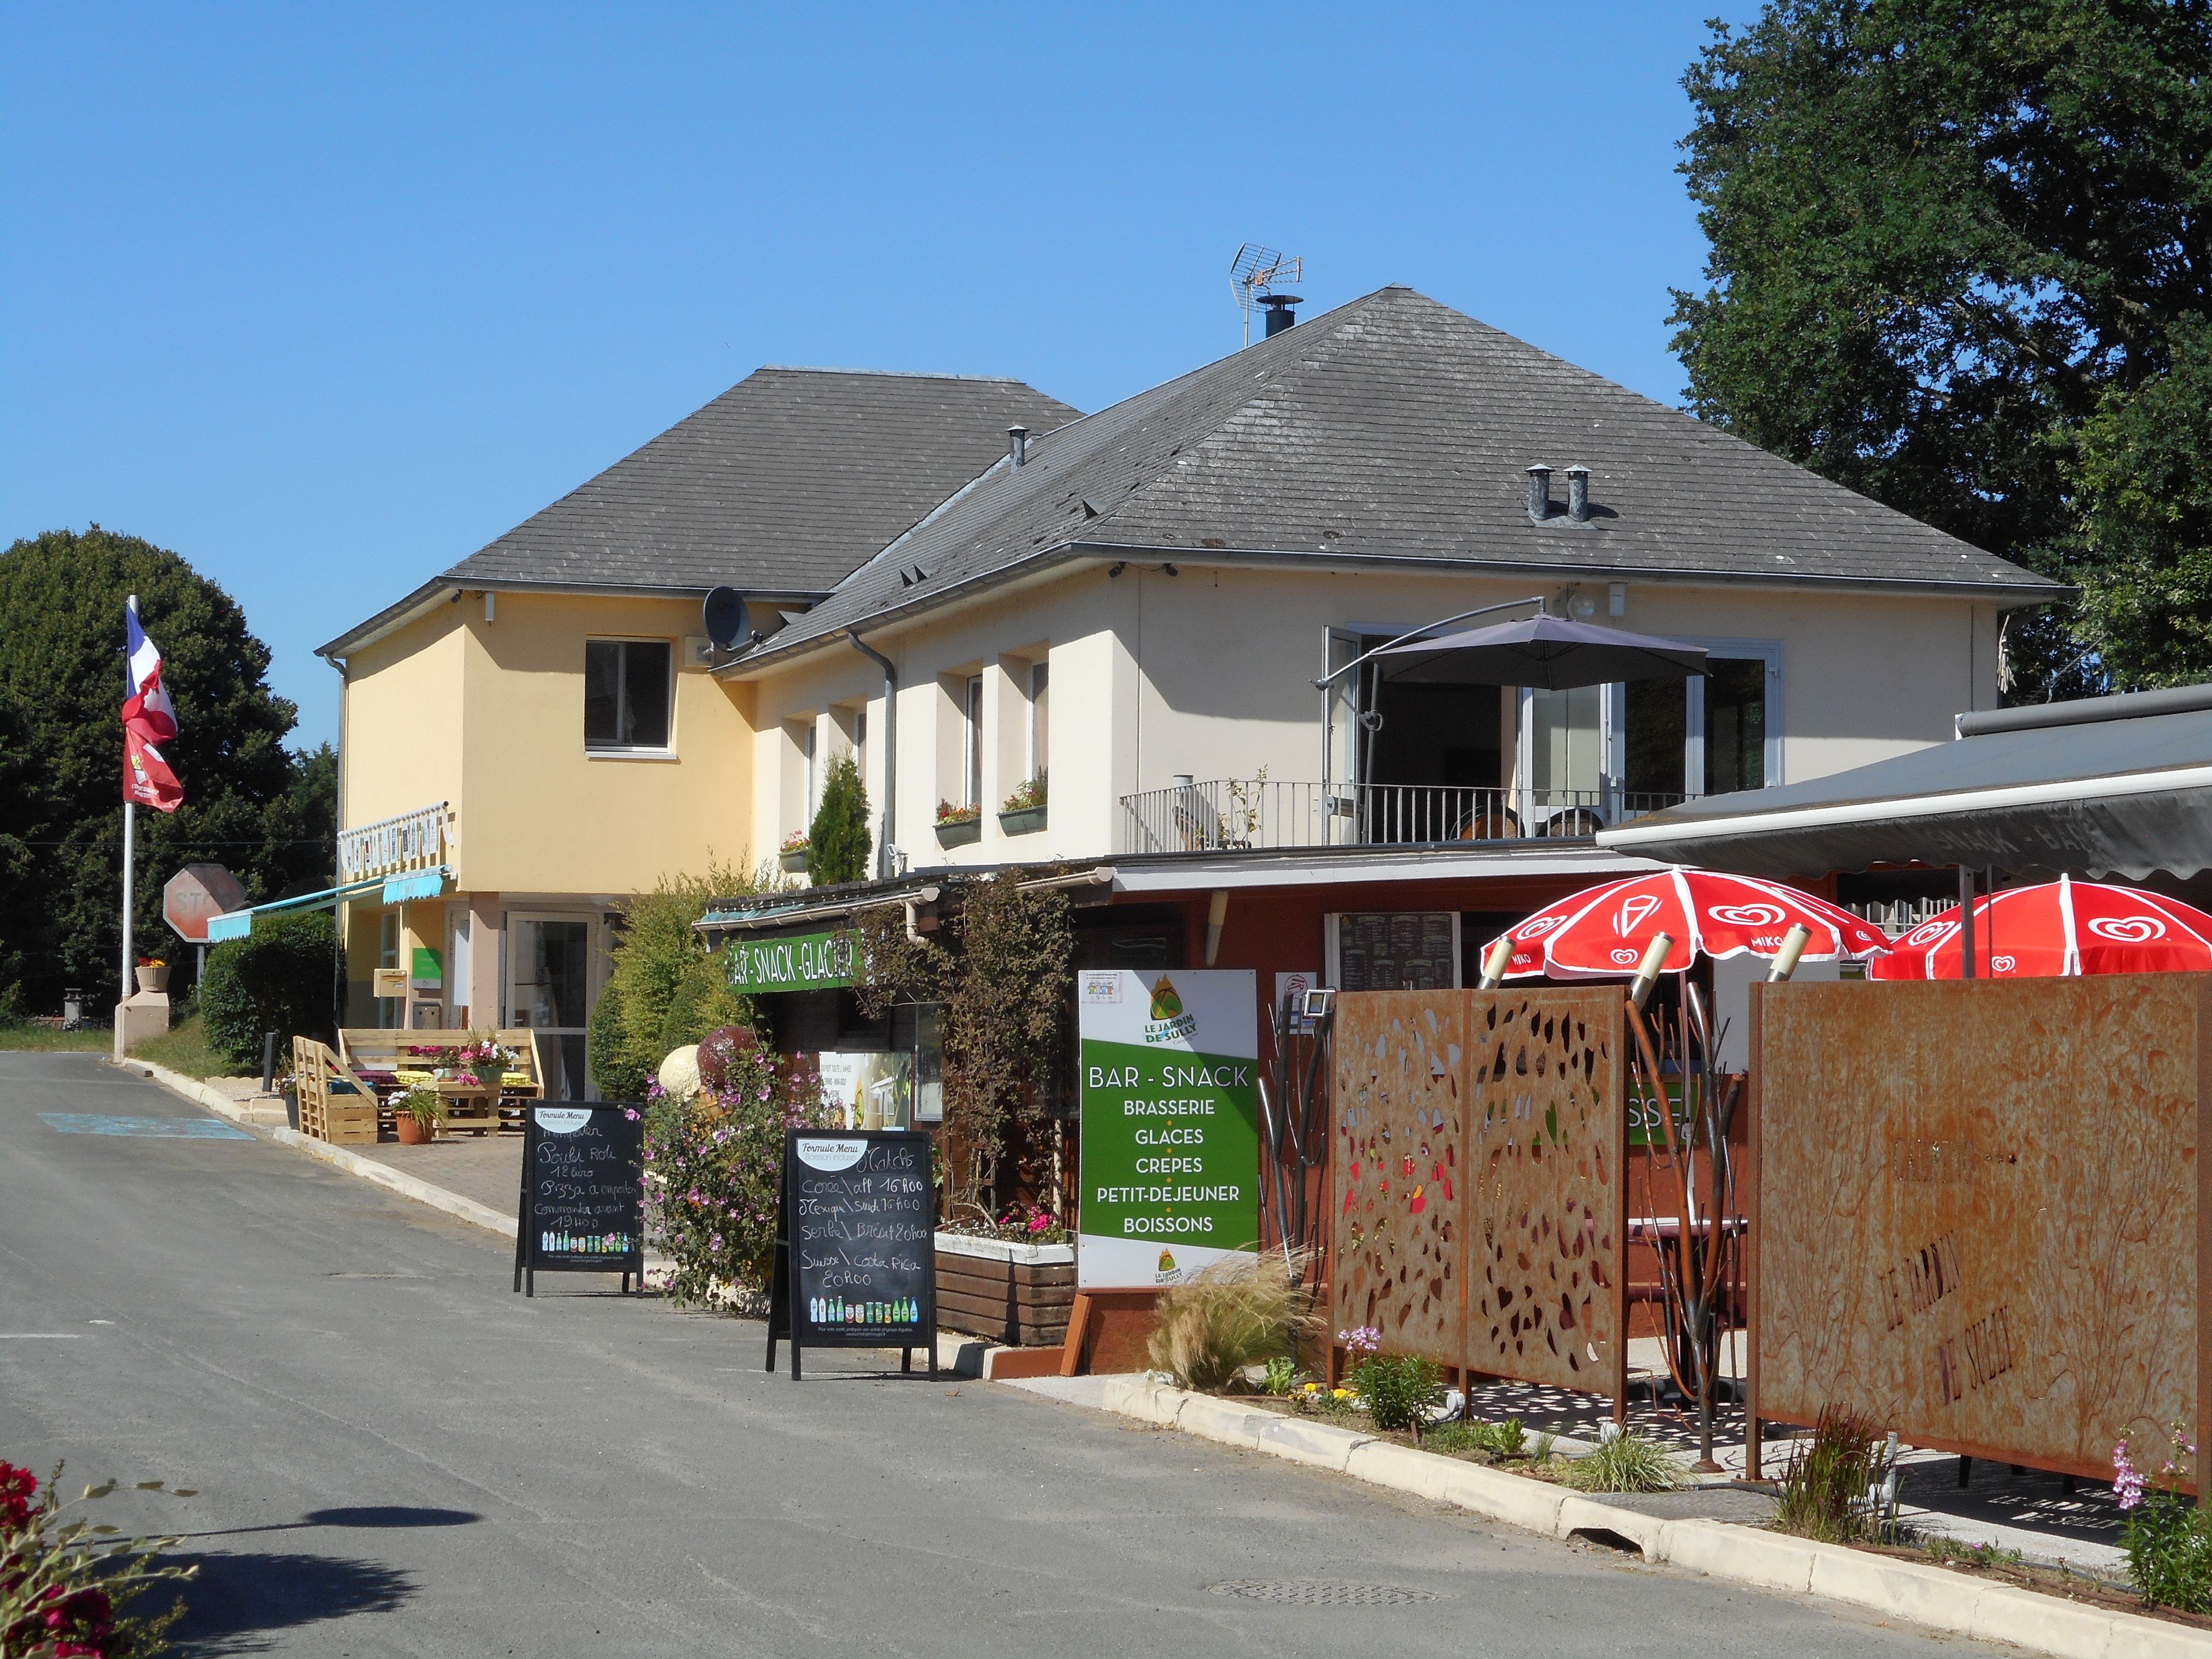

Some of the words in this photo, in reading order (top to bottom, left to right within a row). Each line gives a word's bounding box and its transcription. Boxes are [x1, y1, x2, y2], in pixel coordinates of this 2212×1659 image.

[1751, 936, 1783, 946] MIKO
[755, 945, 796, 984] SNACK
[1512, 953, 1531, 965] MIKO
[1145, 1025, 1156, 1033] LE
[1158, 1013, 1194, 1032] JARDIN
[1145, 1033, 1162, 1043] DE
[1165, 1022, 1197, 1041] SULLY
[1089, 1066, 1139, 1088] BAR
[1162, 1066, 1249, 1088] SNACK
[540, 1111, 566, 1119] Formule
[566, 1111, 585, 1119] Menu
[1124, 1100, 1215, 1116] BRASSERIE
[1135, 1128, 1204, 1145] GLACES
[802, 1143, 836, 1153] Formule
[835, 1143, 858, 1153] Menu
[805, 1153, 831, 1161] Boisson
[1136, 1157, 1202, 1173] CREPES
[541, 1180, 585, 1199] Pizza
[1097, 1185, 1239, 1203] PETIT-DEJEUNER
[1124, 1217, 1213, 1233] BOISSONS
[1162, 1267, 1181, 1278] JARDIN
